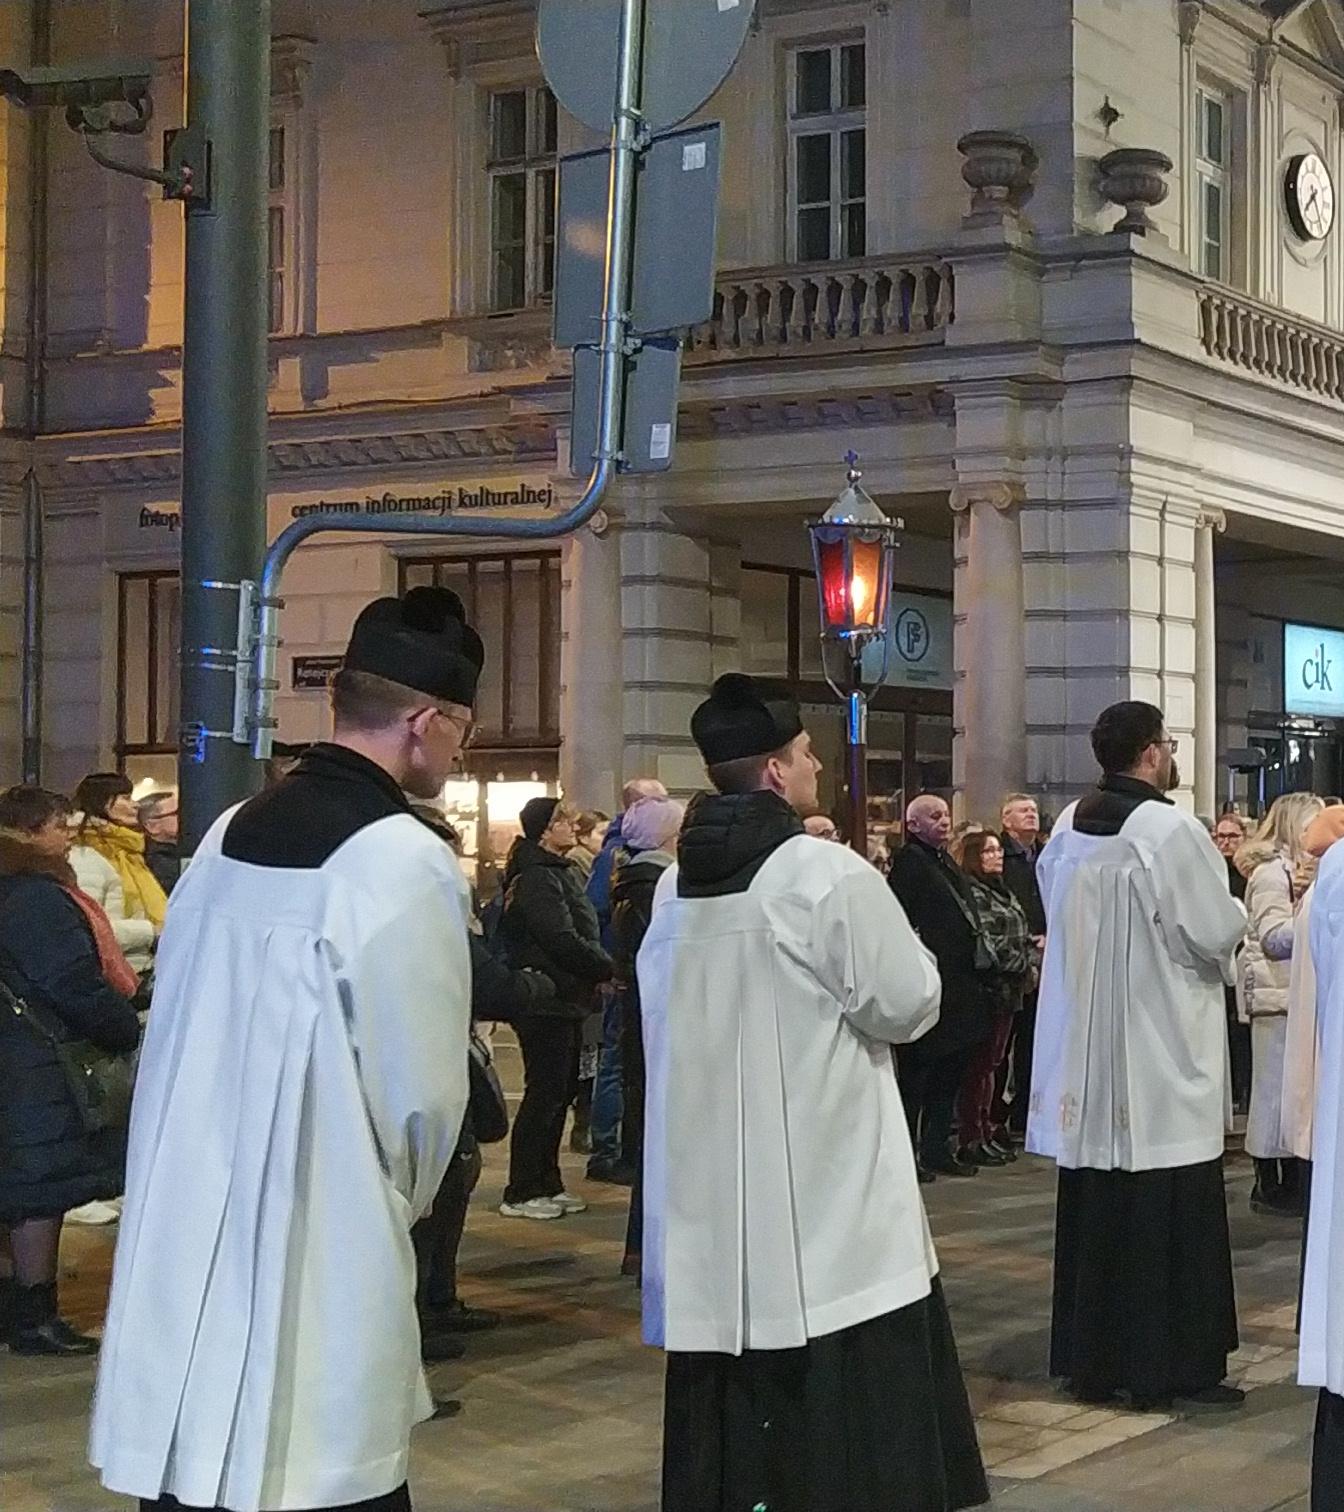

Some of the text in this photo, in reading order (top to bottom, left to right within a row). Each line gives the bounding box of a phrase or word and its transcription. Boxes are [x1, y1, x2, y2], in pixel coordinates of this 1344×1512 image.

[291, 483, 553, 518] centrum informacji kulturalnej
[140, 507, 181, 532] fotop
[1302, 643, 1332, 691] cik
